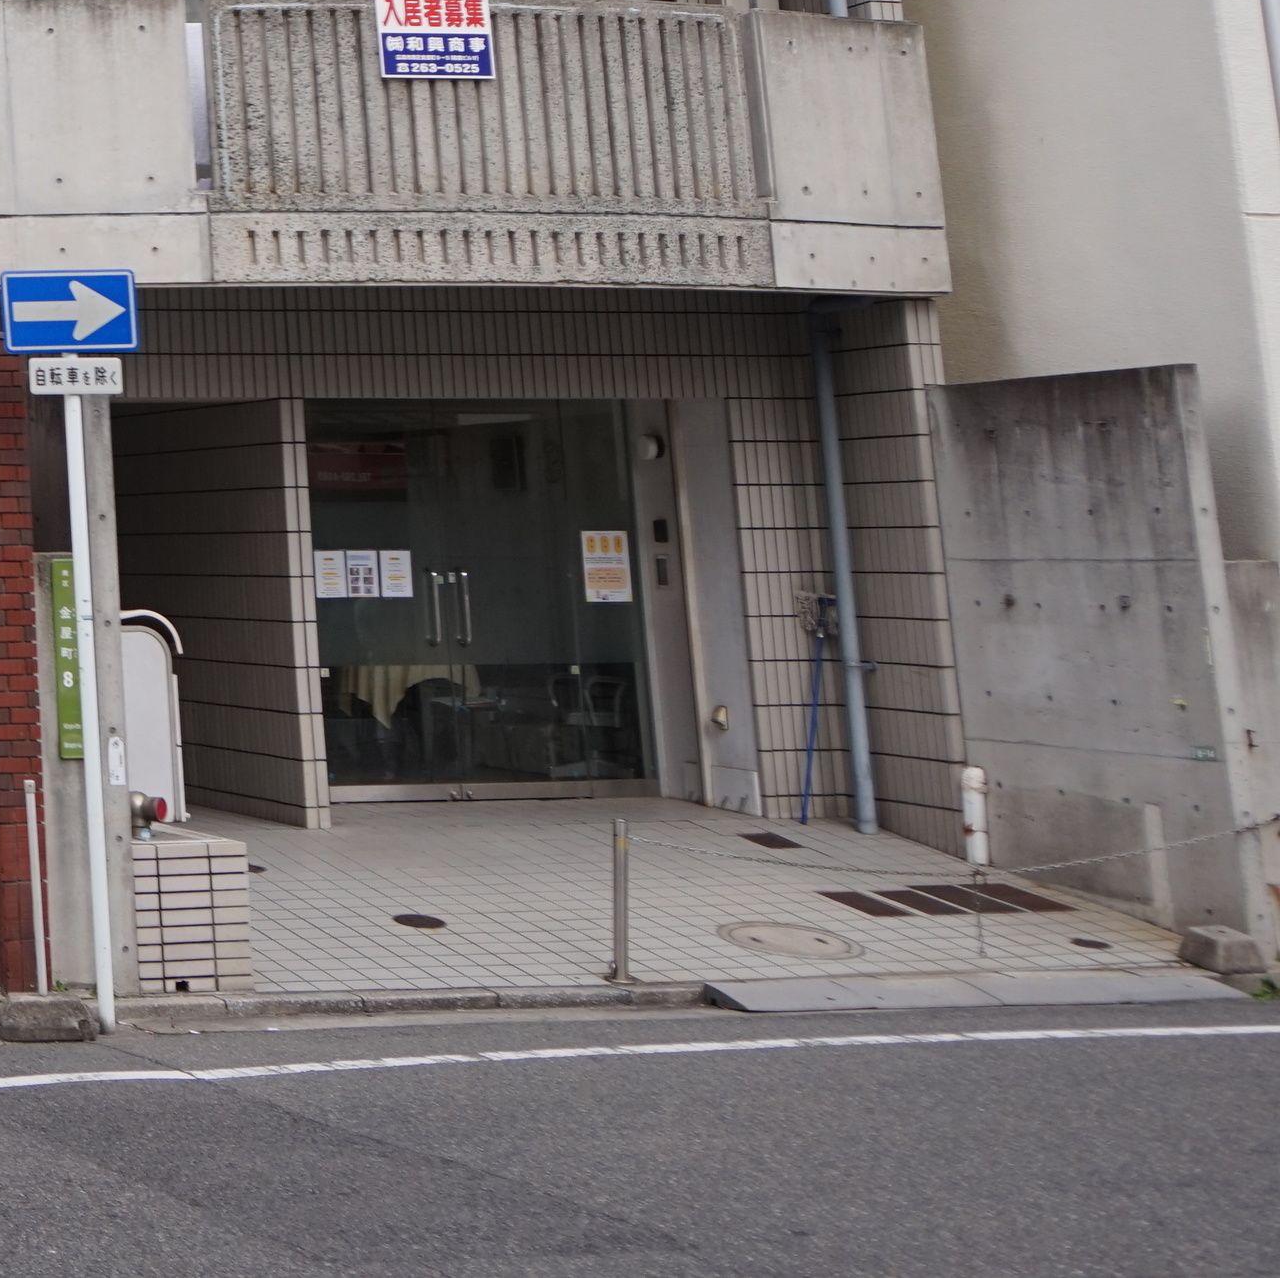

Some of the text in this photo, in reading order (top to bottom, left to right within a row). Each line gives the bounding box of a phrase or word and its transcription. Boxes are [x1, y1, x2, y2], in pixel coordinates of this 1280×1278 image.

[35, 366, 118, 387] 自転車を除く
[59, 605, 73, 660] 金屋町
